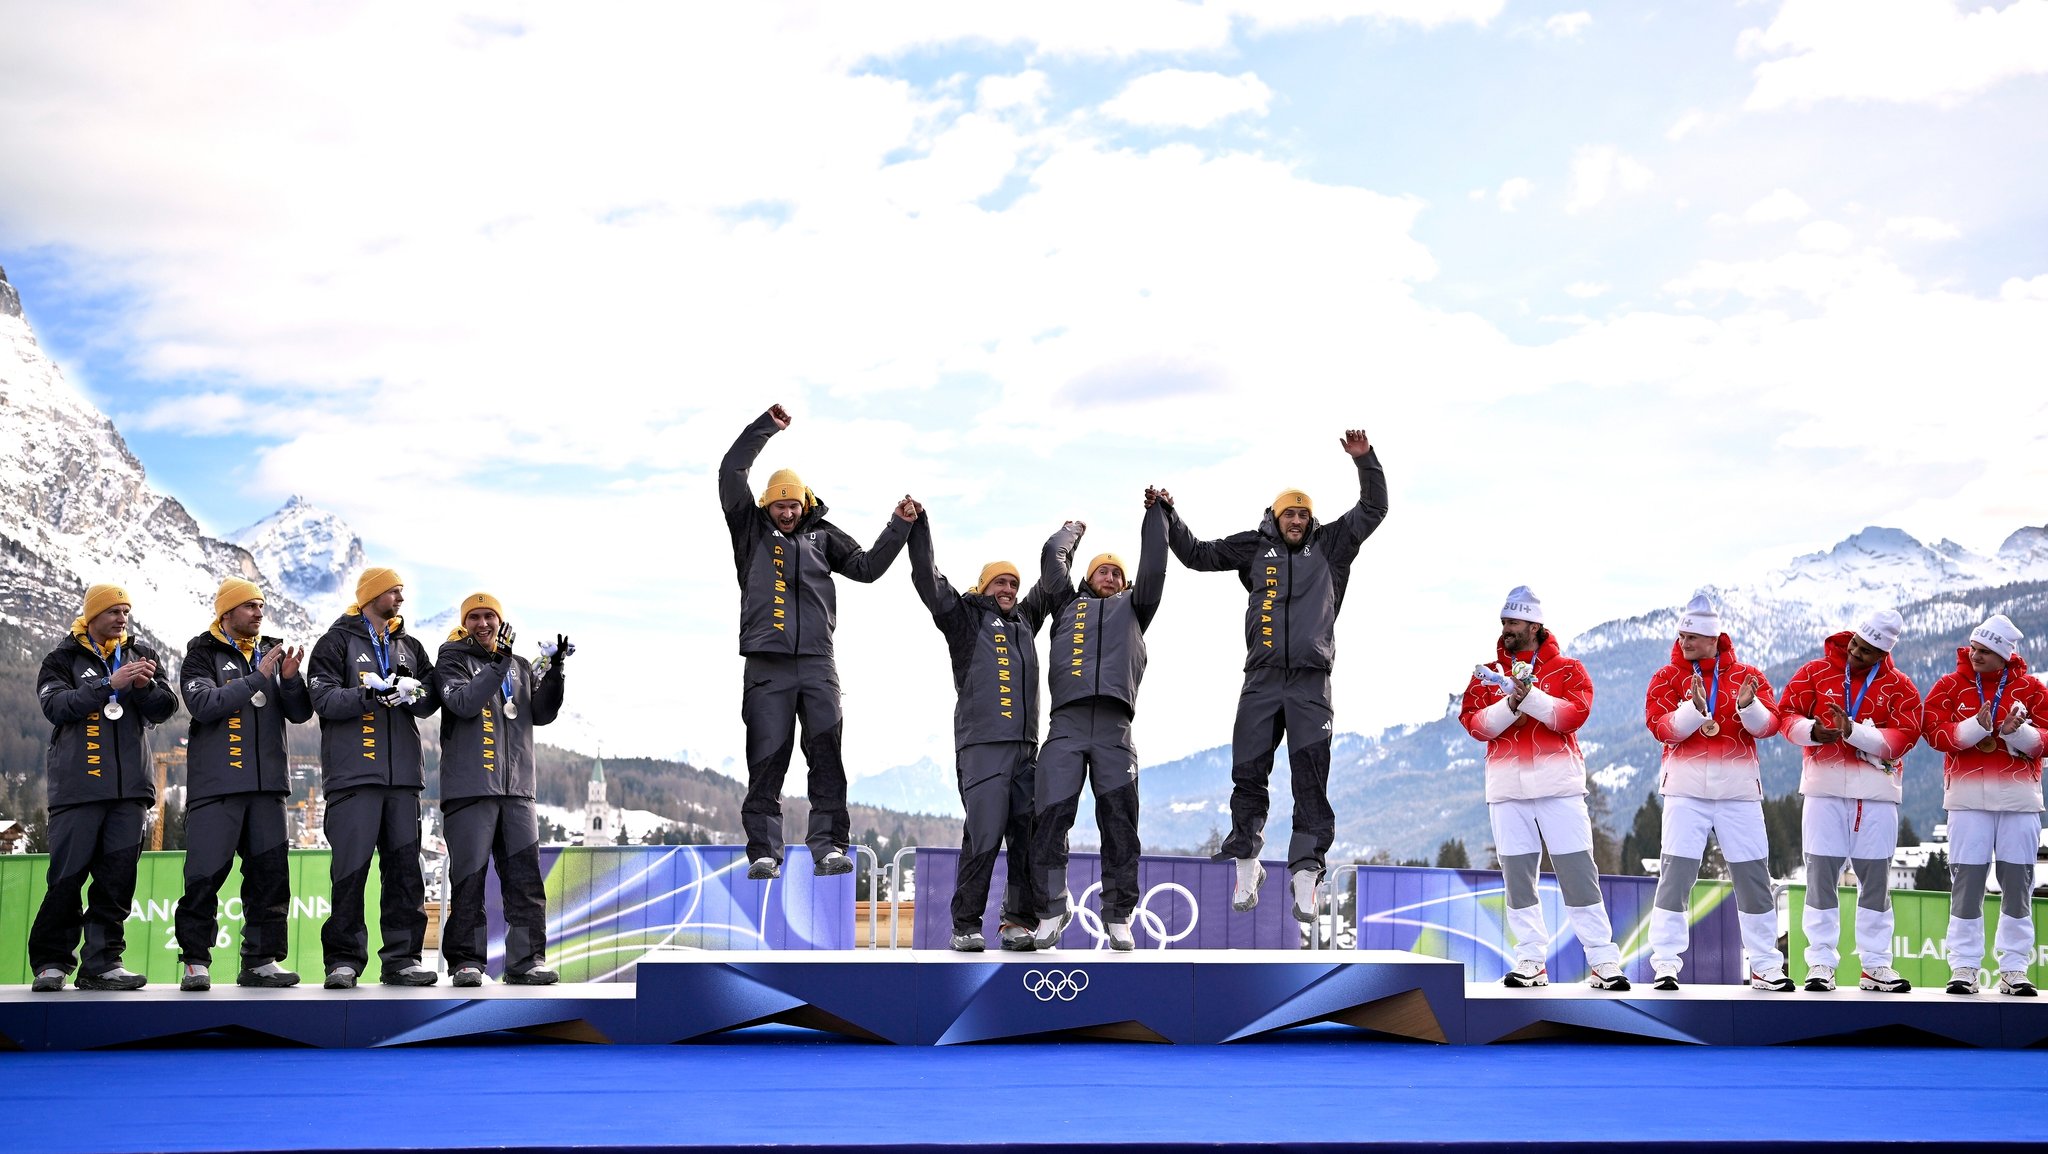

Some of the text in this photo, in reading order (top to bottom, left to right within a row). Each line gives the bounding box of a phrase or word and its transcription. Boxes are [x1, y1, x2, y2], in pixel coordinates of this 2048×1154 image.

[1071, 602, 1088, 677] GERMANY
[1261, 566, 1278, 648] GERMANY
[994, 634, 1012, 719] GERMANY
[86, 711, 102, 777] RMANY
[481, 701, 495, 771] RMANY
